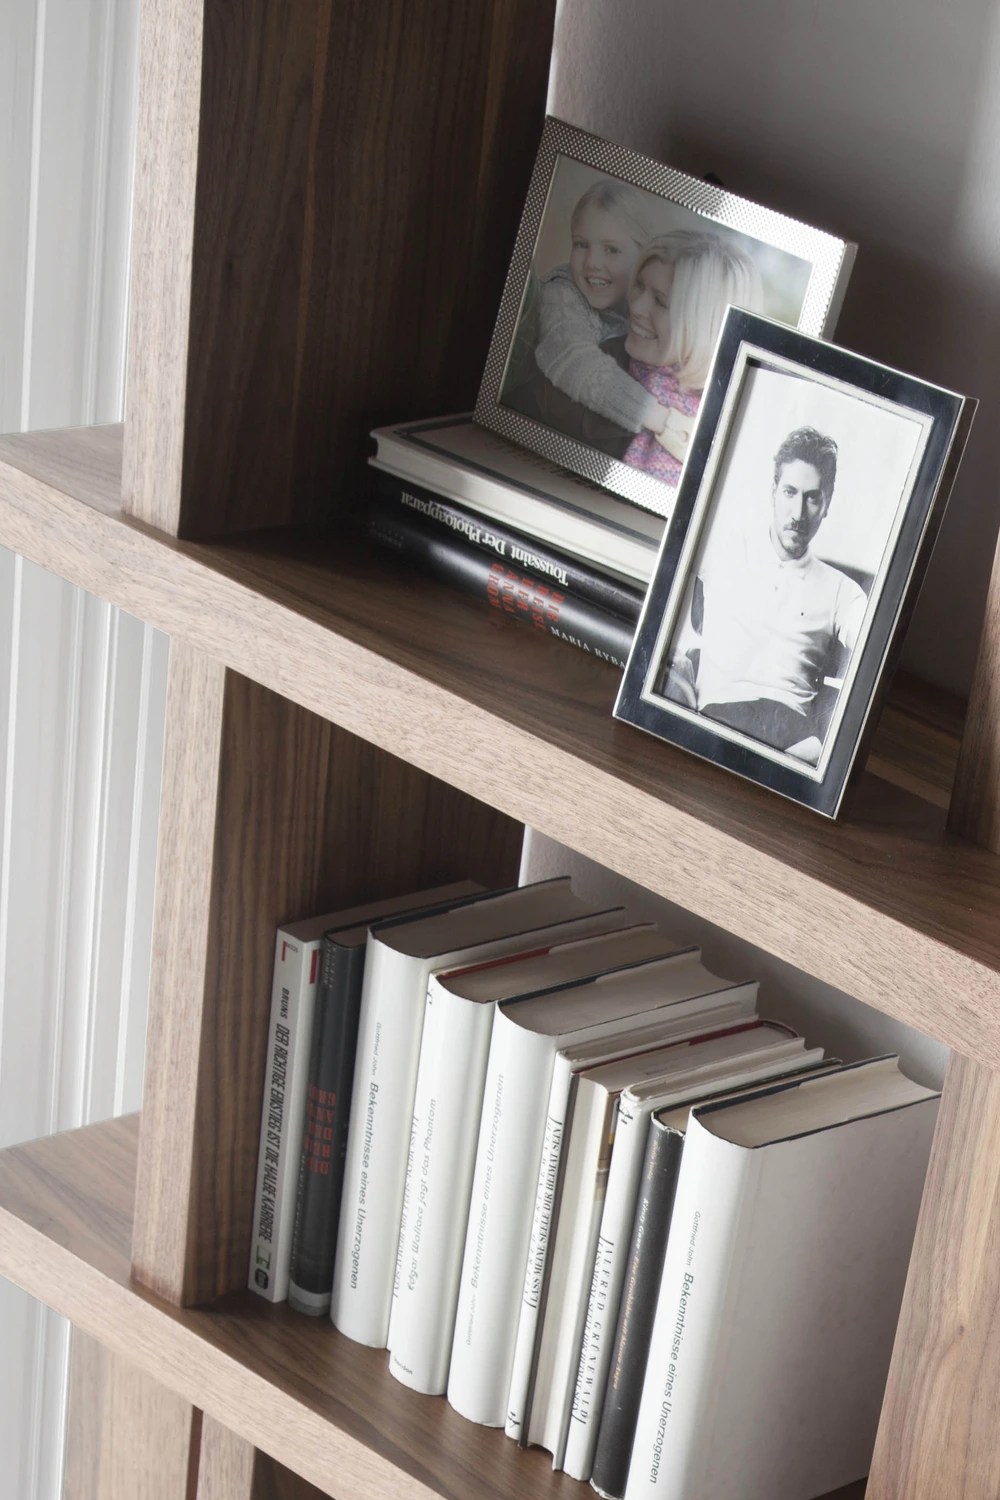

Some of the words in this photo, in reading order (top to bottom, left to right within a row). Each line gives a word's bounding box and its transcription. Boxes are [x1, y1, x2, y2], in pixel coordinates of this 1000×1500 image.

[401, 491, 481, 543] Photoapparat
[481, 532, 505, 555] Der
[511, 546, 569, 587] Toussaint
[279, 987, 291, 1020] BRUNS
[276, 1023, 290, 1047] DER
[271, 1042, 289, 1091] RICHTIGE
[267, 1085, 286, 1132] EINSTIEG
[361, 1082, 379, 1169] Bekenntnisse
[424, 1098, 436, 1151] Phantom
[265, 1146, 280, 1167] DIE
[266, 1130, 281, 1150] IST
[551, 1128, 562, 1153] SEIN
[262, 1160, 279, 1194] HALBE
[421, 1154, 429, 1178] das
[546, 1154, 558, 1196] HEIMAT
[358, 1170, 368, 1206] eines
[417, 1178, 428, 1208] jagt
[543, 1196, 553, 1214] DIR
[259, 1190, 276, 1244] KARRIERE
[470, 1202, 489, 1290] Bekenntnisse
[483, 1165, 493, 1201] eines
[539, 1213, 551, 1246] SEELE
[689, 1210, 701, 1250] Gottfried
[350, 1206, 367, 1290] Unerzogenen
[412, 1213, 424, 1258] Wallace
[534, 1247, 547, 1276] MEINE
[686, 1250, 694, 1266] John
[530, 1280, 542, 1307] LASS
[670, 1271, 694, 1361] Bekenntnisse
[664, 1362, 678, 1398] eines
[649, 1400, 673, 1484] Unerzogenen
